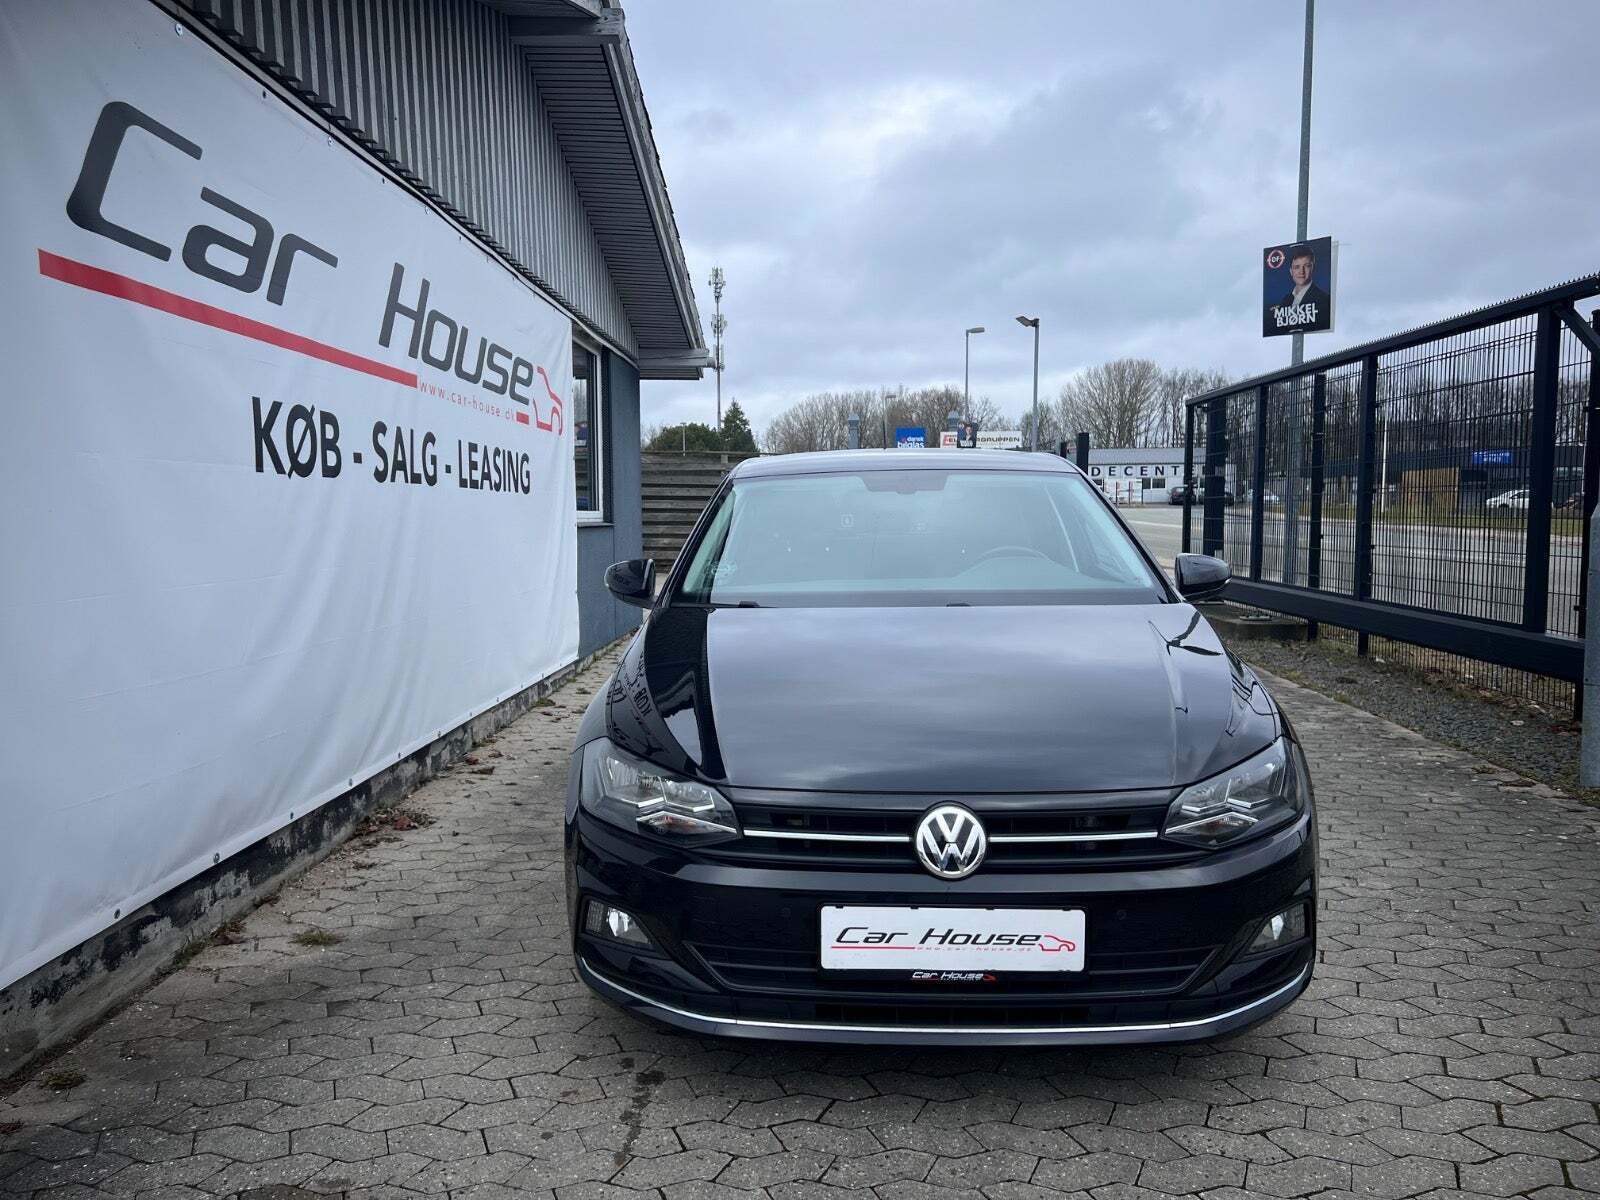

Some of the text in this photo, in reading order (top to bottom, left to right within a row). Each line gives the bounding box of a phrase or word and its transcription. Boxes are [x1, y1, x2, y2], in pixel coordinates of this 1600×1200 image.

[66, 101, 534, 406] Car House
[1274, 303, 1318, 318] MIKKEL
[1276, 312, 1316, 327] BJØRN
[252, 396, 342, 479] KØB
[372, 421, 437, 486] SALG
[458, 439, 531, 495] LEASING
[836, 926, 1042, 945] Car House
[912, 971, 984, 980] Car House
